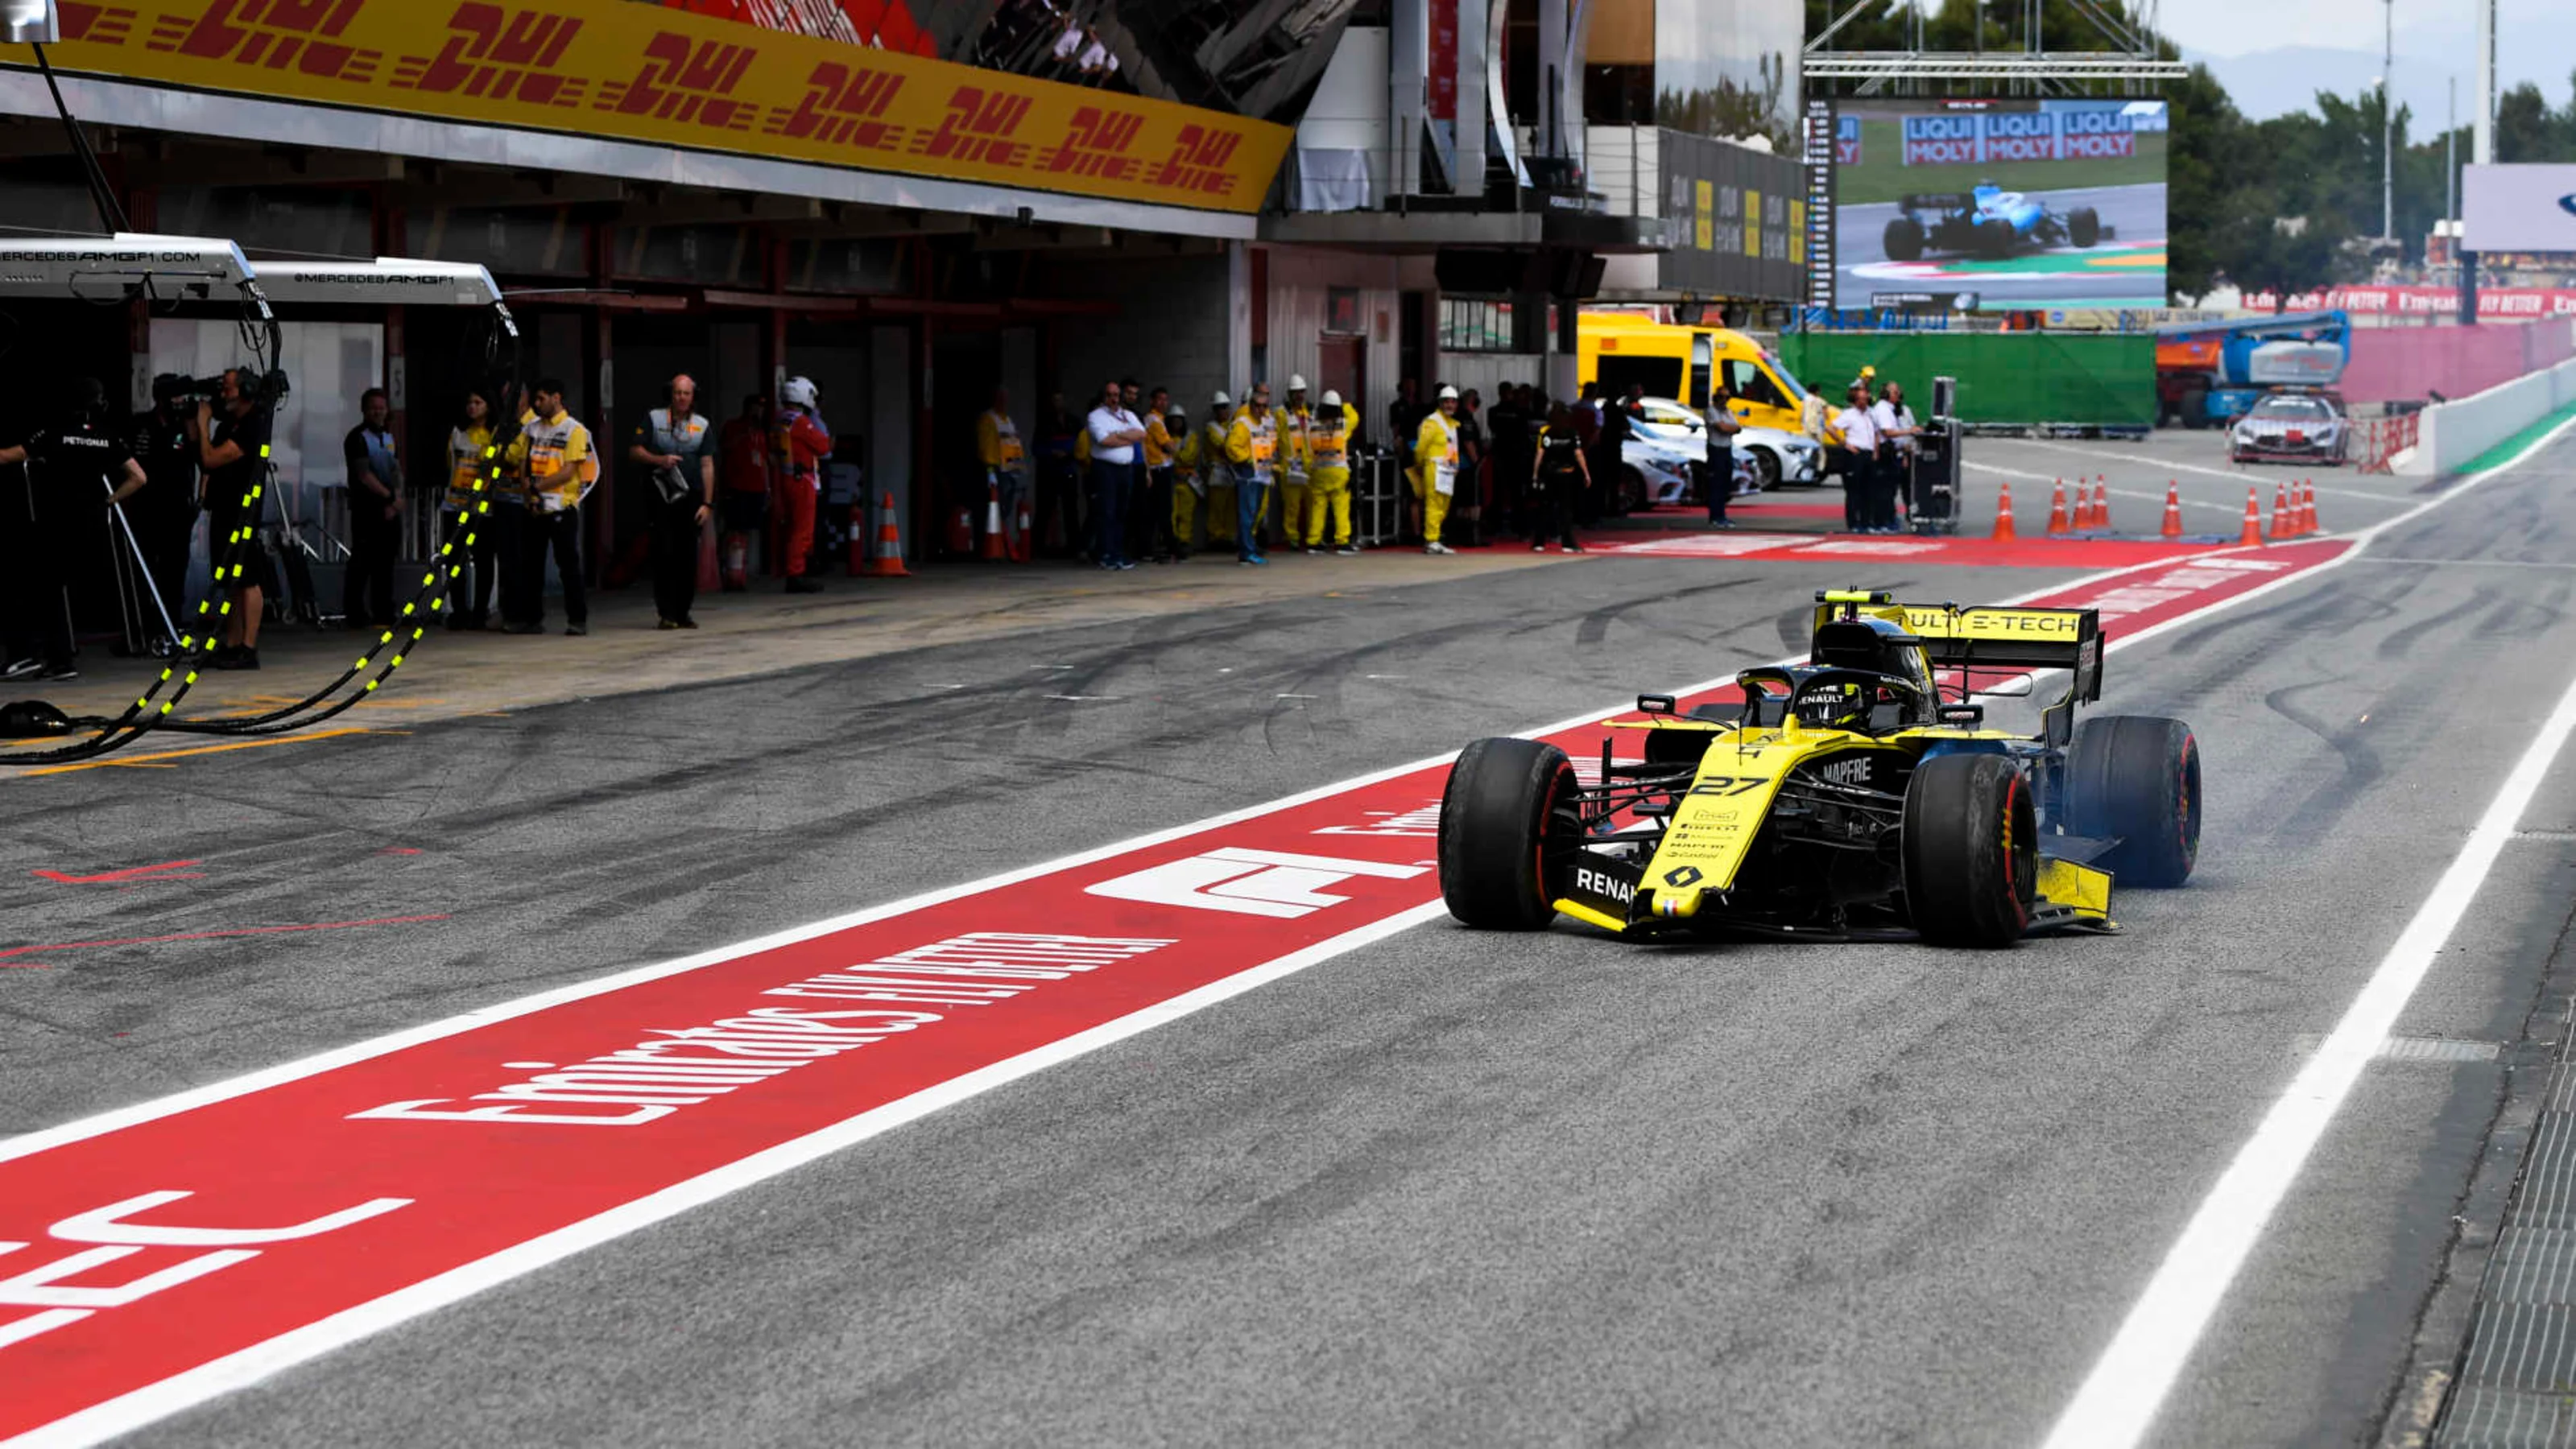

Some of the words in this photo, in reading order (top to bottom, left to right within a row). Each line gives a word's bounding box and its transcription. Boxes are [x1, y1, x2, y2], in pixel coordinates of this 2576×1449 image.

[416, 1, 584, 104] DHL
[616, 31, 757, 127] DHL
[781, 60, 906, 148] DHL
[925, 85, 1033, 165] DHL
[1908, 119, 1974, 139] LIQUI
[1988, 117, 2051, 137] LIQUI
[1049, 105, 1146, 179] DHL
[1910, 142, 1973, 162] MOLY
[1990, 139, 2051, 159] MOLY
[2066, 135, 2130, 156] MOLY
[1157, 122, 1243, 193] DHL
[1972, 615, 2077, 632] E-TECH
[1798, 694, 1844, 705] ENAULT
[1689, 776, 1770, 796] 27
